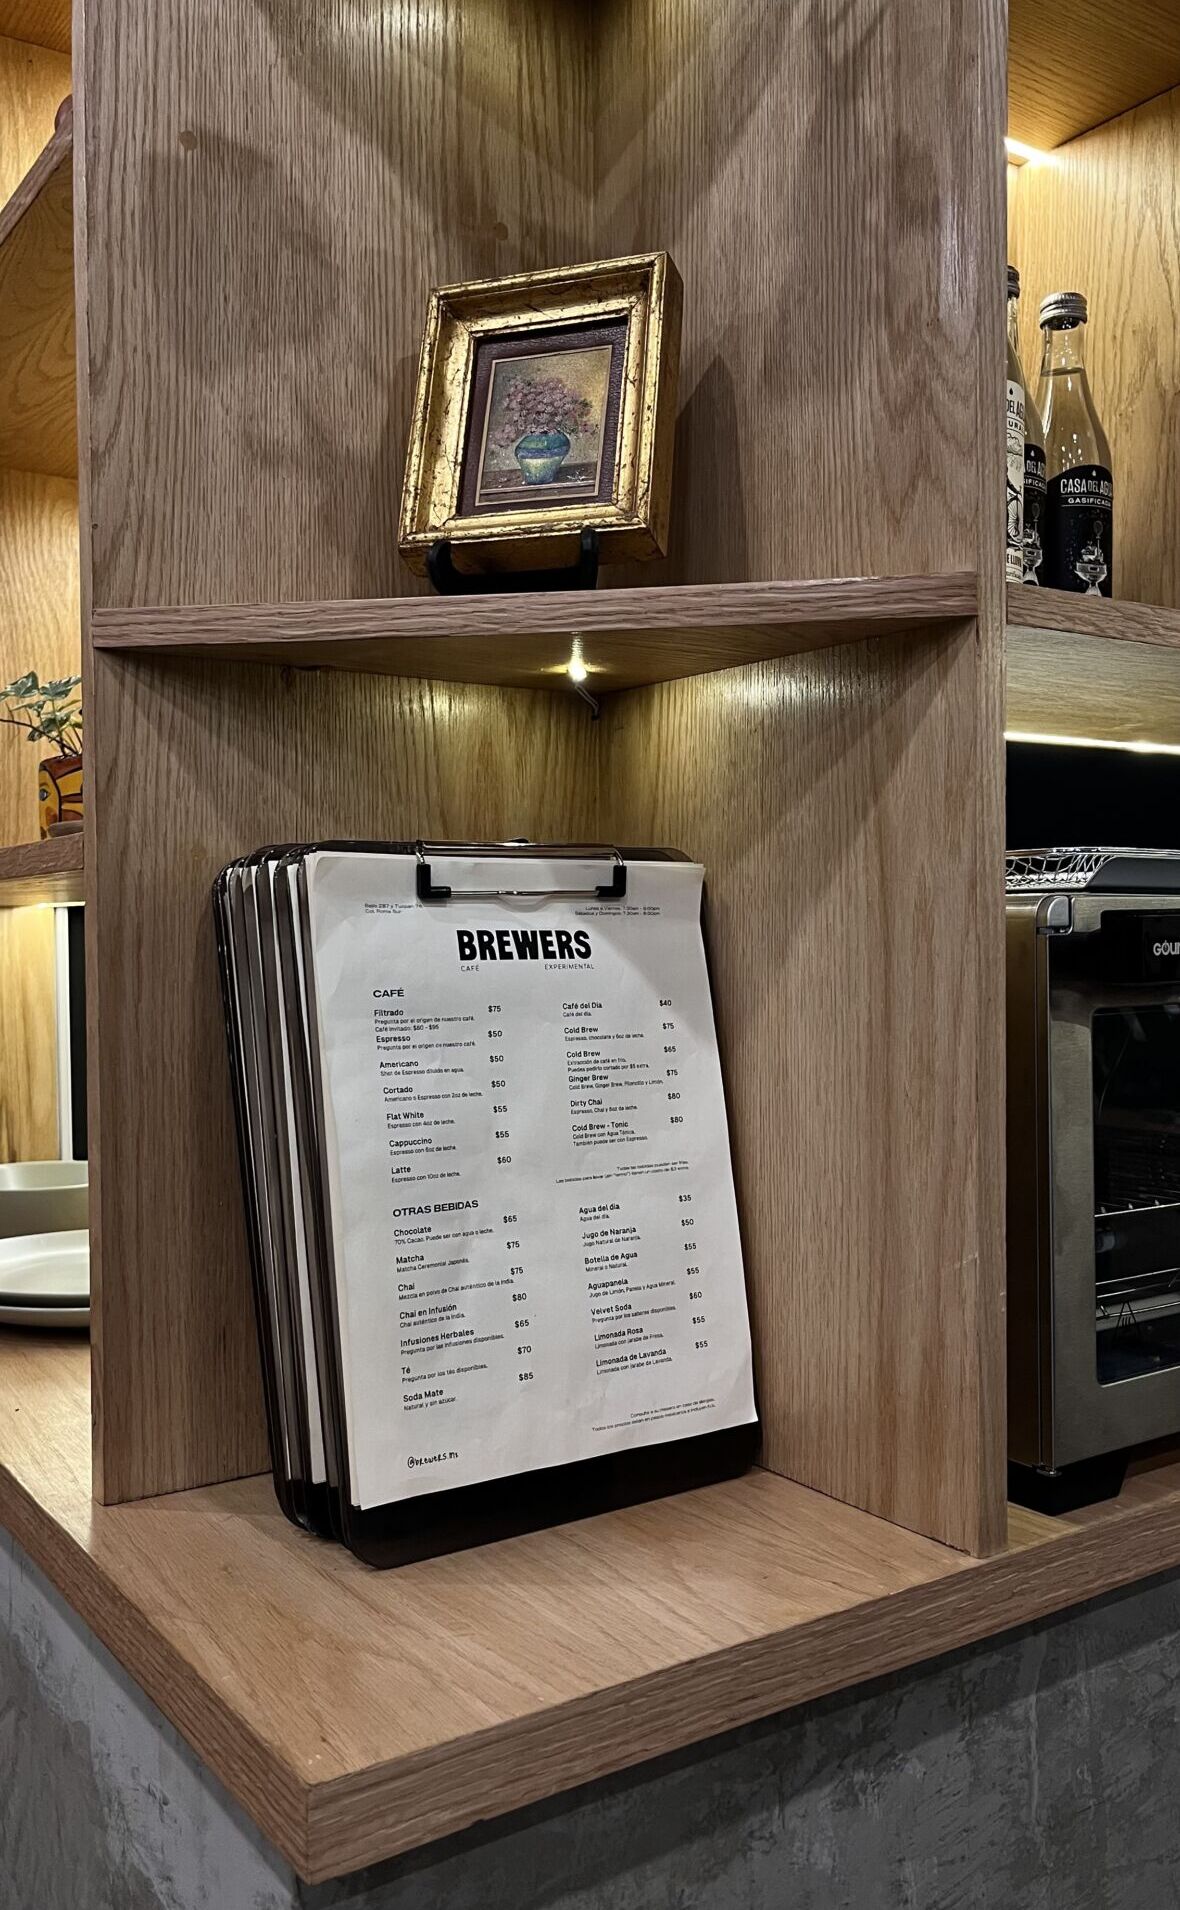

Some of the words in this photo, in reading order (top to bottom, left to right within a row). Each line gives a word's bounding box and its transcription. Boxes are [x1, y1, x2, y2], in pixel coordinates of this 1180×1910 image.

[1060, 478, 1088, 494] CASA
[1087, 479, 1100, 493] DEL
[456, 930, 591, 961] BREWERS
[460, 964, 479, 972] CAFÉ
[373, 987, 404, 998] CAFÉ
[562, 1002, 579, 1010] Café
[659, 999, 672, 1007] $40
[374, 1009, 404, 1017] Filtrado
[488, 1005, 501, 1013] $75
[662, 1022, 675, 1030] $75
[487, 1030, 503, 1038] $50
[376, 1035, 411, 1043] Espresso
[663, 1045, 676, 1053] $65
[489, 1055, 504, 1063] $50
[379, 1061, 419, 1069] Americano
[568, 1075, 590, 1083] Ginger
[491, 1080, 506, 1088] $50
[383, 1086, 413, 1094] Cortado
[667, 1092, 681, 1100] $80
[587, 1098, 603, 1106] Chai
[493, 1105, 508, 1113] $55
[386, 1113, 401, 1121] Flat
[670, 1116, 684, 1124] $80
[571, 1124, 588, 1132] Cold
[495, 1130, 510, 1139] $55
[389, 1137, 433, 1148] Cappuccino
[497, 1156, 512, 1164] $60
[391, 1166, 411, 1174] Latte
[678, 1194, 692, 1202] $35
[392, 1205, 431, 1217] OTRAS
[433, 1199, 479, 1213] BEBIDAS
[579, 1207, 597, 1215] Agua
[597, 1204, 609, 1212] del
[503, 1214, 517, 1224] $65
[681, 1218, 694, 1227] $50
[393, 1226, 432, 1237] Chocolate
[609, 1227, 637, 1235] Naranja
[506, 1240, 520, 1250] $75
[684, 1242, 697, 1251] $55
[396, 1254, 424, 1264] Matcha
[584, 1256, 610, 1265] Botella
[620, 1252, 638, 1260] Agua
[510, 1266, 524, 1276] $75
[686, 1266, 700, 1275] $55
[397, 1282, 415, 1292] Chai
[587, 1278, 628, 1291] Aguapanela
[512, 1292, 527, 1302] $80
[689, 1291, 702, 1300] $60
[399, 1310, 416, 1320] Chai
[417, 1309, 427, 1317] en
[428, 1304, 457, 1315] Infusión
[590, 1306, 614, 1316] Velvet
[614, 1303, 632, 1312] Soda
[514, 1319, 530, 1328] $65
[692, 1315, 705, 1325] $55
[400, 1335, 439, 1347] Infusiones
[440, 1329, 474, 1340] Herbales
[594, 1330, 626, 1342] Limonada
[627, 1327, 643, 1335] Rosa
[695, 1340, 708, 1349] $55
[517, 1345, 532, 1355] $70
[595, 1355, 629, 1367] Limonada
[638, 1349, 667, 1359] Lavanda
[401, 1366, 411, 1374] Té
[518, 1371, 534, 1381] $85
[403, 1392, 423, 1402] Soda
[424, 1389, 444, 1398] Mate
